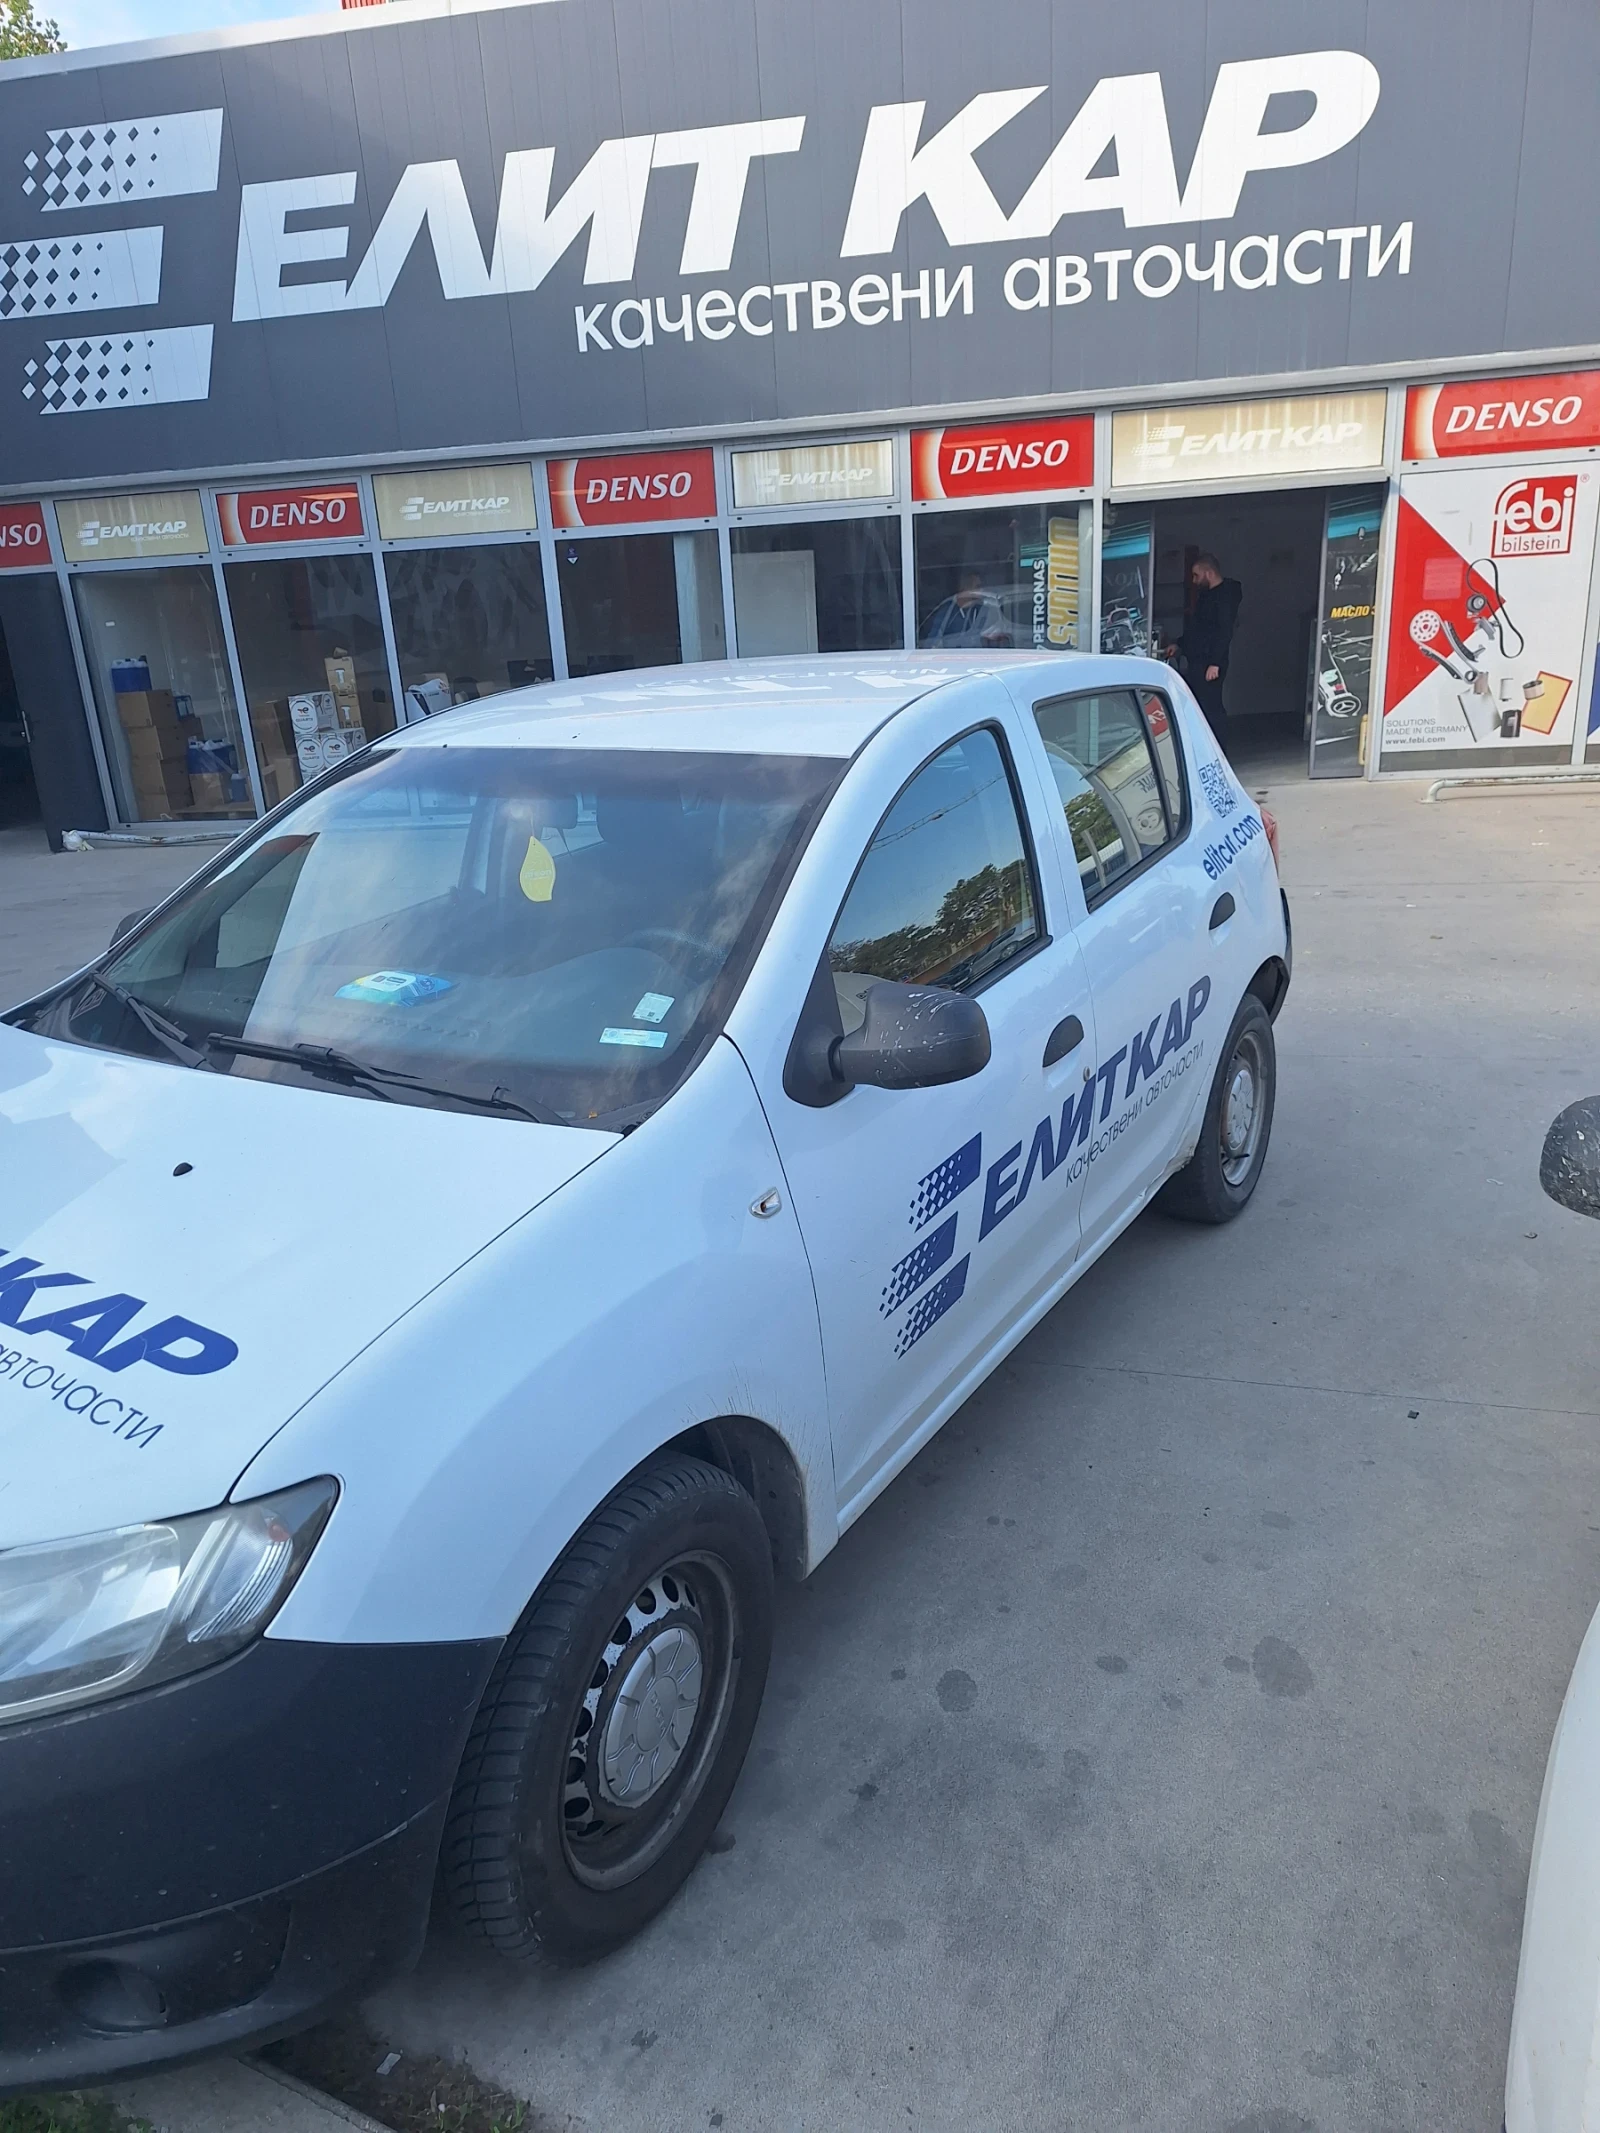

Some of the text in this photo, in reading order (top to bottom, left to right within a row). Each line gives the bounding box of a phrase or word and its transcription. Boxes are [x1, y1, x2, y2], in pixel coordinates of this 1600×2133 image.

[232, 50, 1381, 322] ЕЛИТ КАР
[574, 221, 1413, 353] качествени авточасти
[1445, 395, 1583, 434] DENSO
[950, 439, 1069, 475] DENSO
[586, 472, 692, 504] DENSO
[250, 499, 346, 529] DENSO
[1495, 481, 1575, 536] febi
[1501, 536, 1560, 552] bilstein
[1033, 559, 1045, 643] PETRONAS
[1331, 605, 1370, 618] МАСЛО
[1385, 736, 1445, 745] www.febi.com
[1386, 718, 1436, 727] SOLUTIONS
[1386, 727, 1410, 735] MADE
[1424, 725, 1467, 734] GERMANY
[1065, 1040, 1204, 1188] качествени авточасти
[0, 1248, 239, 1375] КАР
